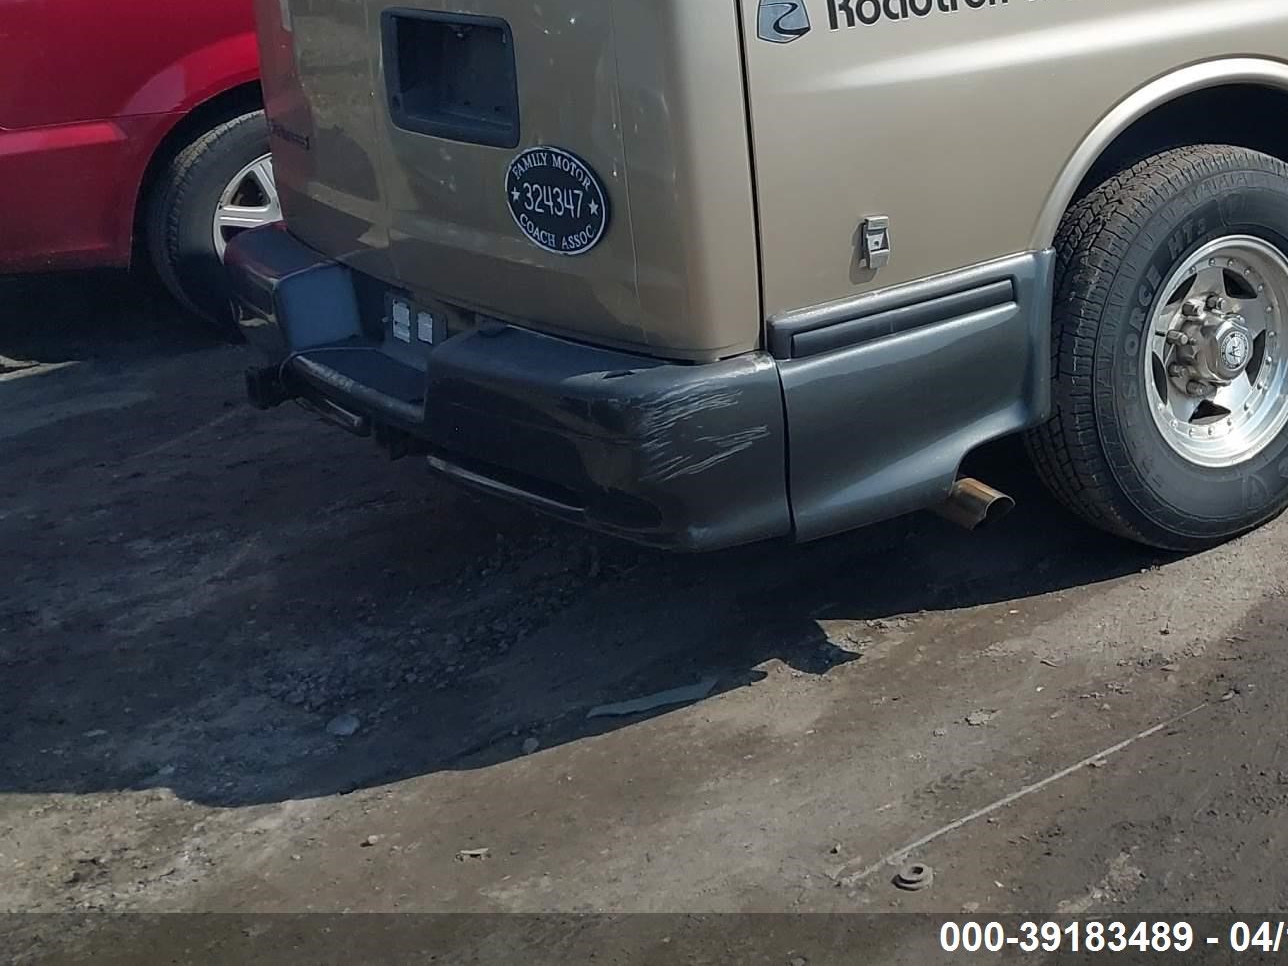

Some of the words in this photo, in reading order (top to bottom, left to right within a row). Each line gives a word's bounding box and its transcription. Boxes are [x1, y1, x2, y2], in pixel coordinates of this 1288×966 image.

[512, 152, 548, 180] FAMILY
[551, 153, 592, 191] MOTOR
[522, 182, 584, 218] 324347
[519, 213, 556, 248] COACH
